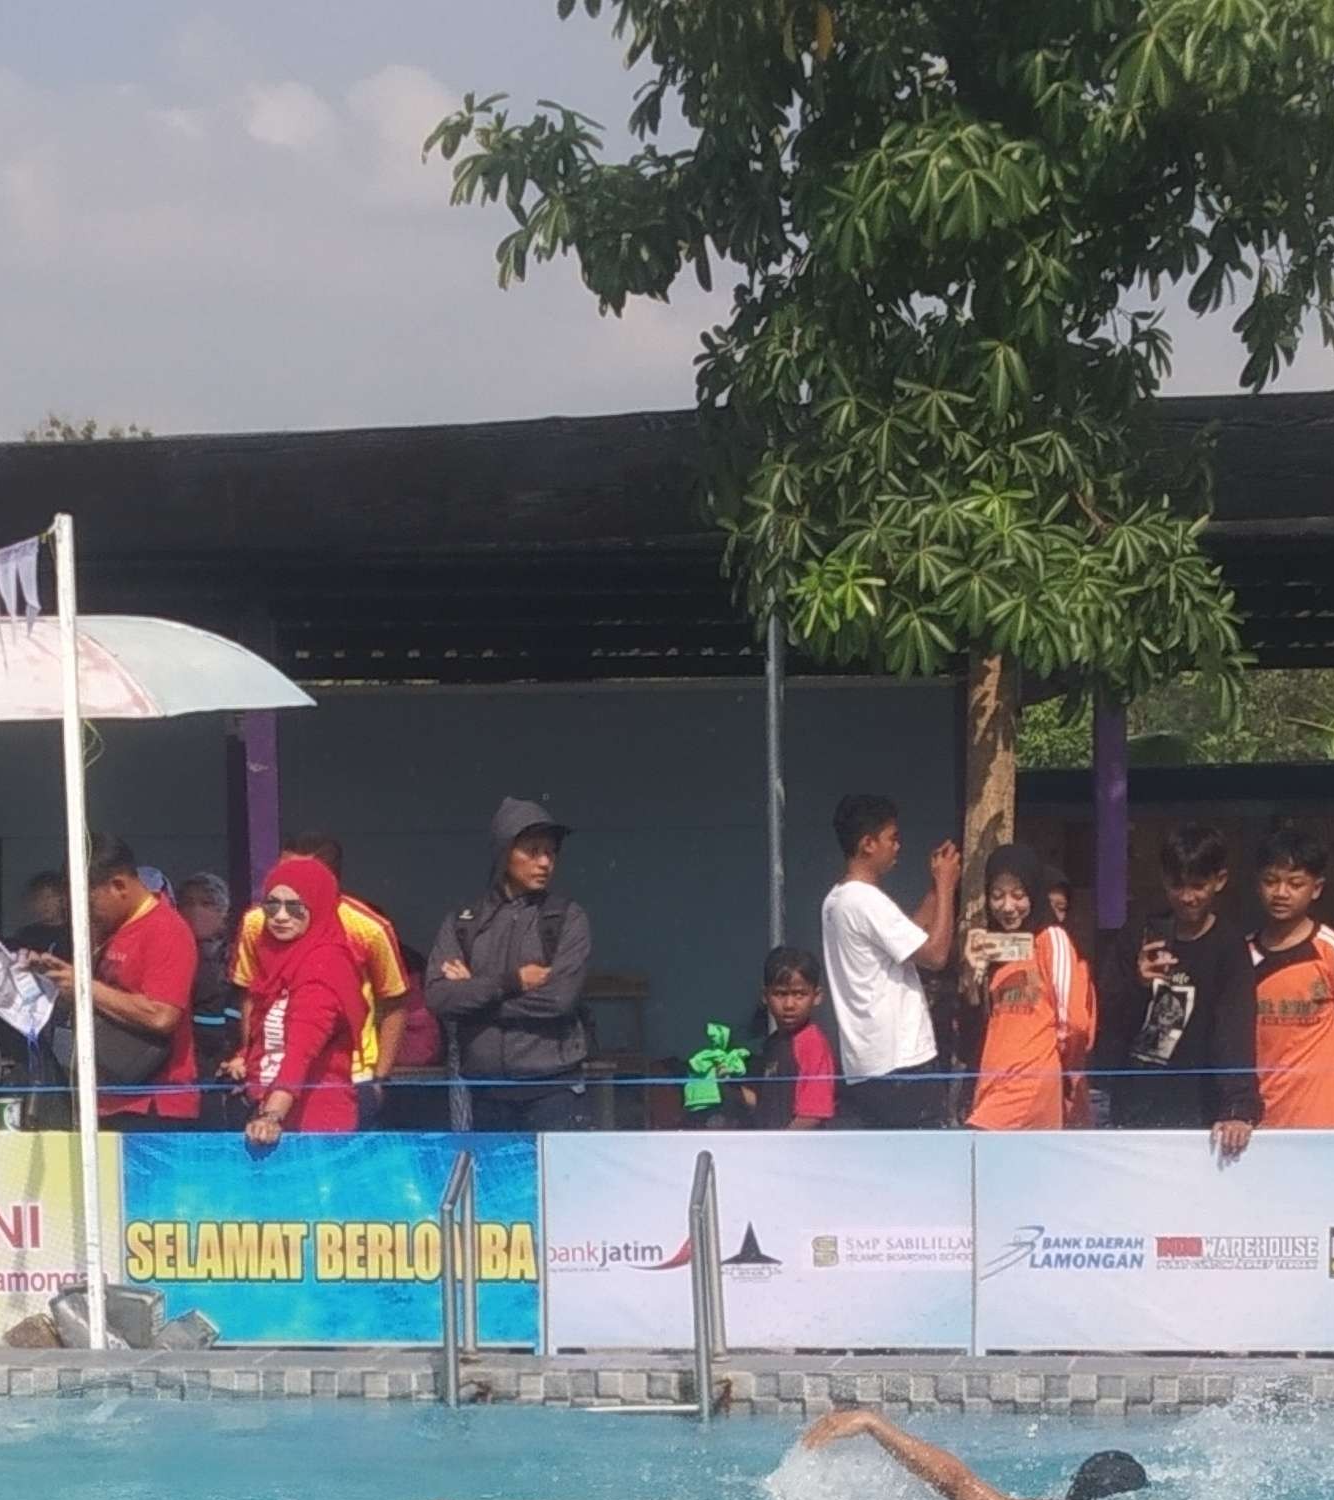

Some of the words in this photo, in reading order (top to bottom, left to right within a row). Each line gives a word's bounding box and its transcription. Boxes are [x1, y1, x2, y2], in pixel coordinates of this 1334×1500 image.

[127, 1222, 307, 1281] SELAMAT
[1042, 1237, 1080, 1250] BANK
[1085, 1237, 1144, 1250] DAERAH
[1029, 1253, 1144, 1269] LAMONGAN
